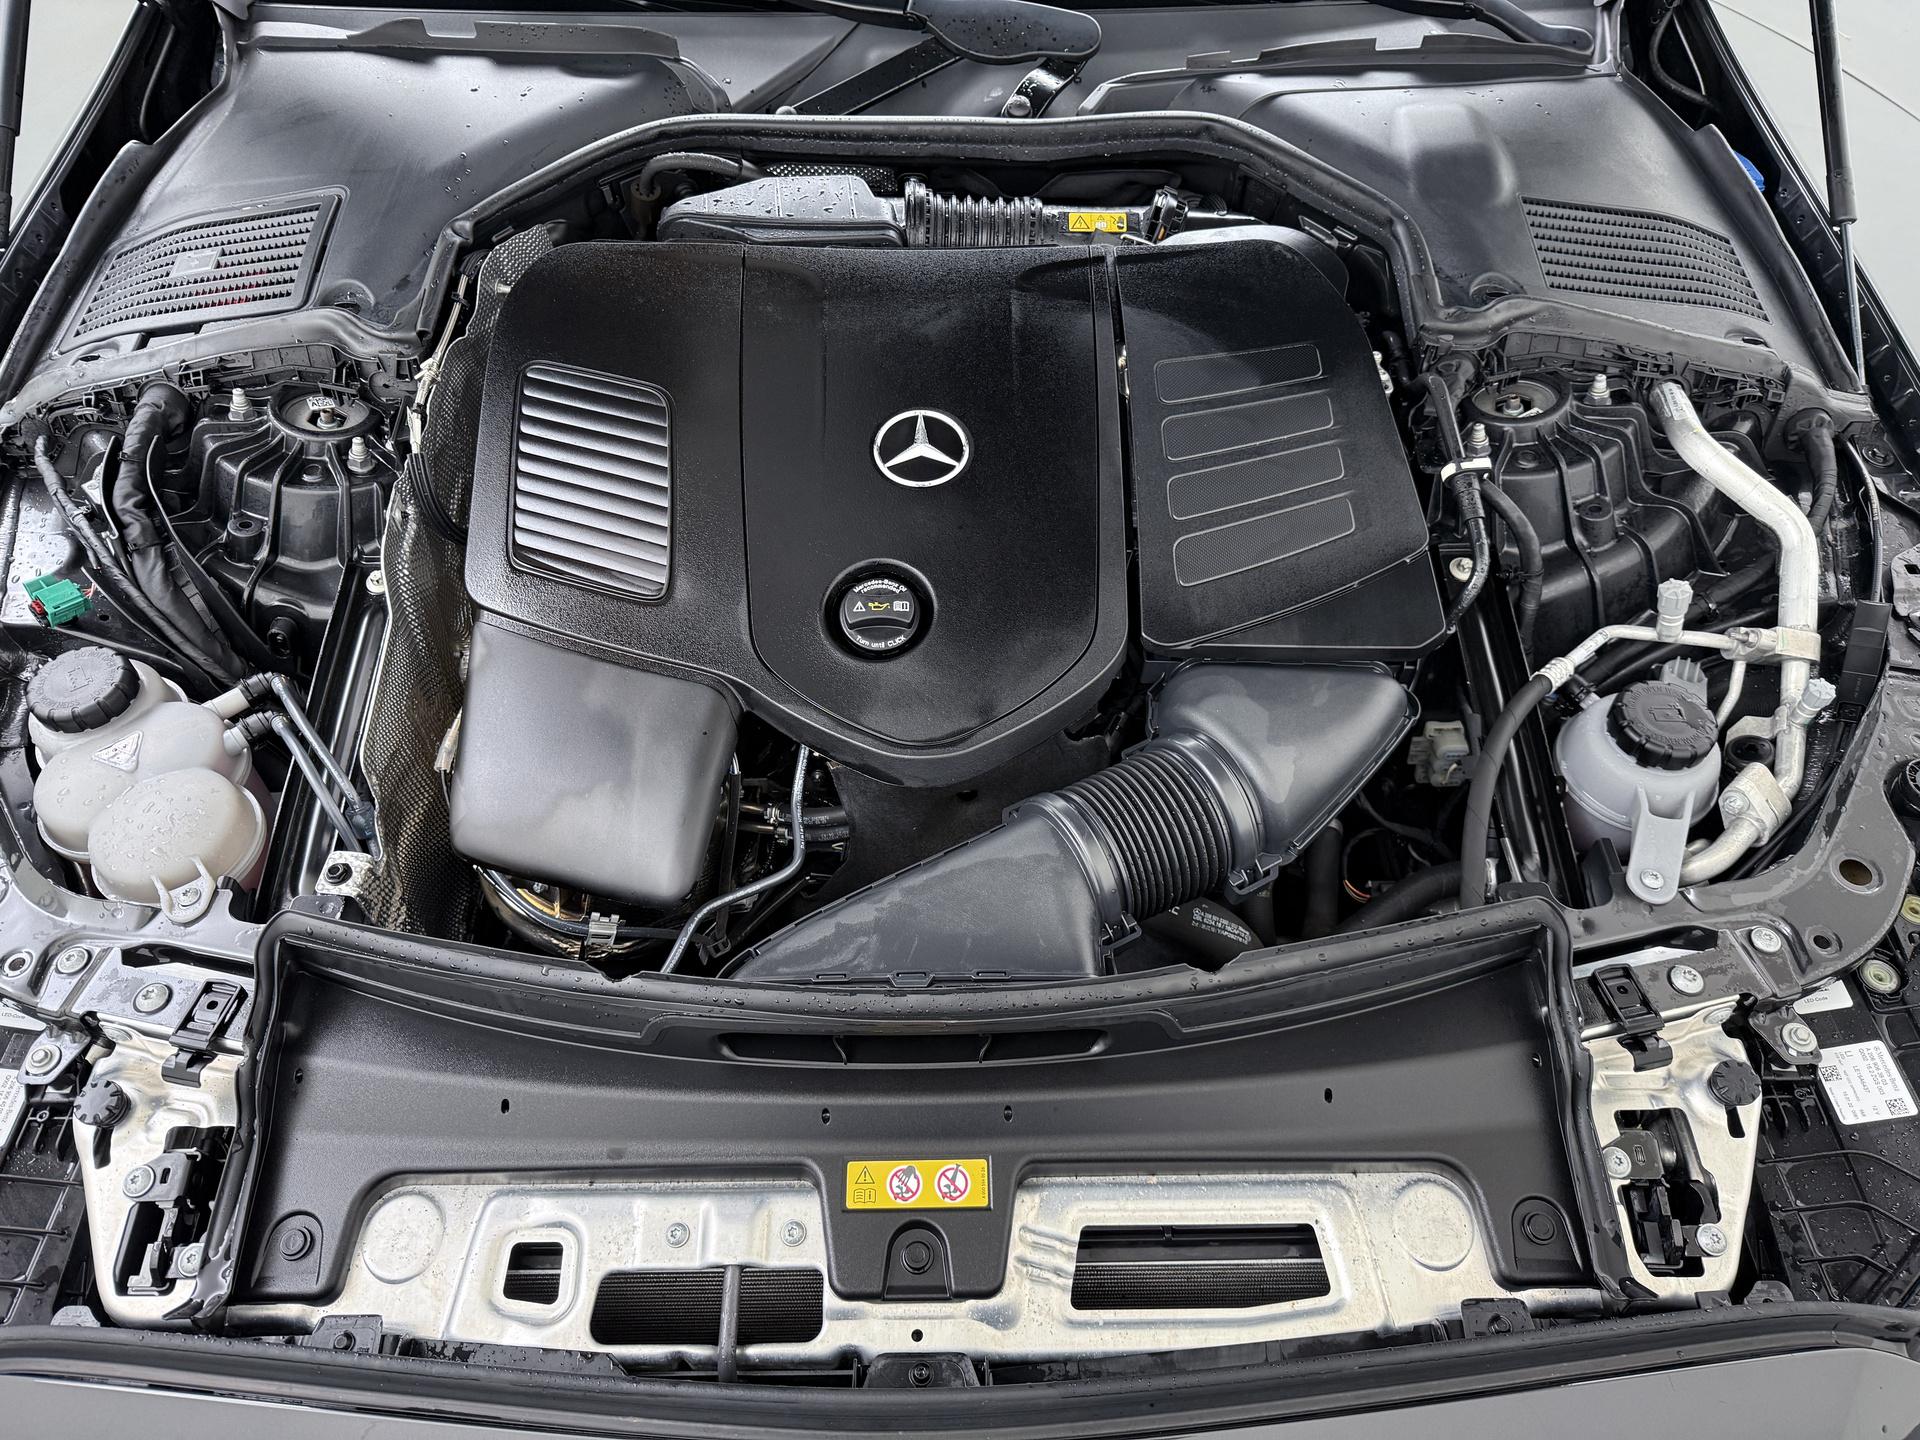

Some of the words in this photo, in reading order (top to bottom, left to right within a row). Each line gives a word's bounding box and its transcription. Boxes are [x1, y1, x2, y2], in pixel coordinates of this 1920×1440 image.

[853, 579, 900, 592] Mercedes-Benz
[860, 584, 900, 594] recommended
[856, 635, 870, 647] Turn
[887, 634, 907, 647] CLICK
[1875, 1052, 1901, 1091] Mercedes-Benz
